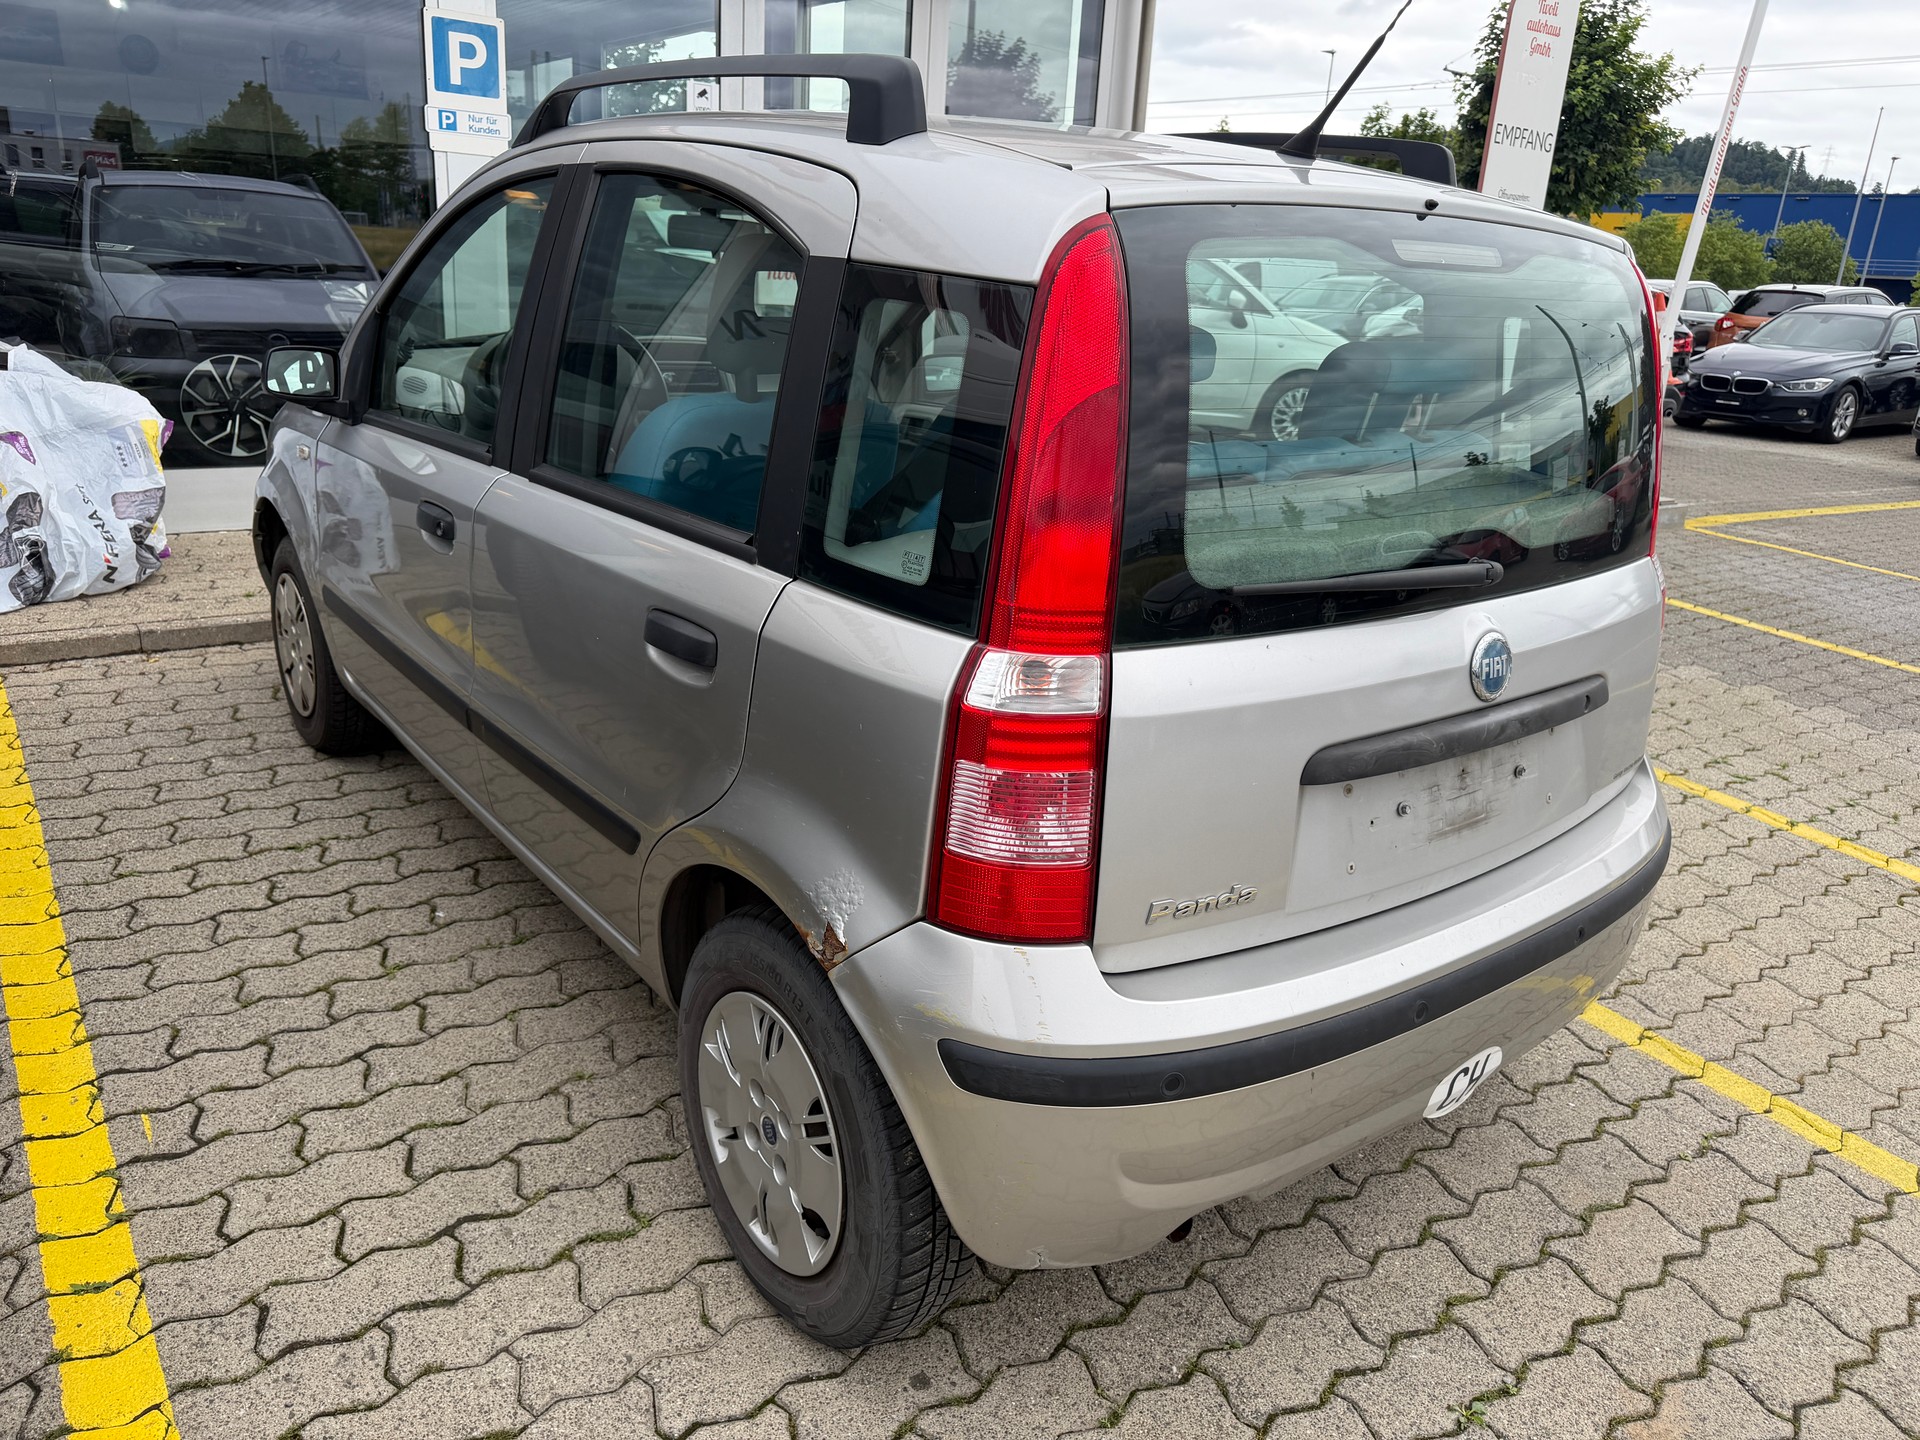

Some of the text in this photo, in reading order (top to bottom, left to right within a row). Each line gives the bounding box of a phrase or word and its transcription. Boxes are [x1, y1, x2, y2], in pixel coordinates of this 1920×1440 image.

[1538, 0, 1559, 16] Tivoli
[1526, 19, 1561, 37] autohaus
[448, 31, 487, 85] P
[468, 114, 499, 125] Nur für
[468, 125, 501, 136] Kunden
[1494, 123, 1554, 153] EMPFANG
[1481, 654, 1508, 680] FIAT
[1144, 883, 1258, 926] Panda
[1436, 1052, 1492, 1112] CH
